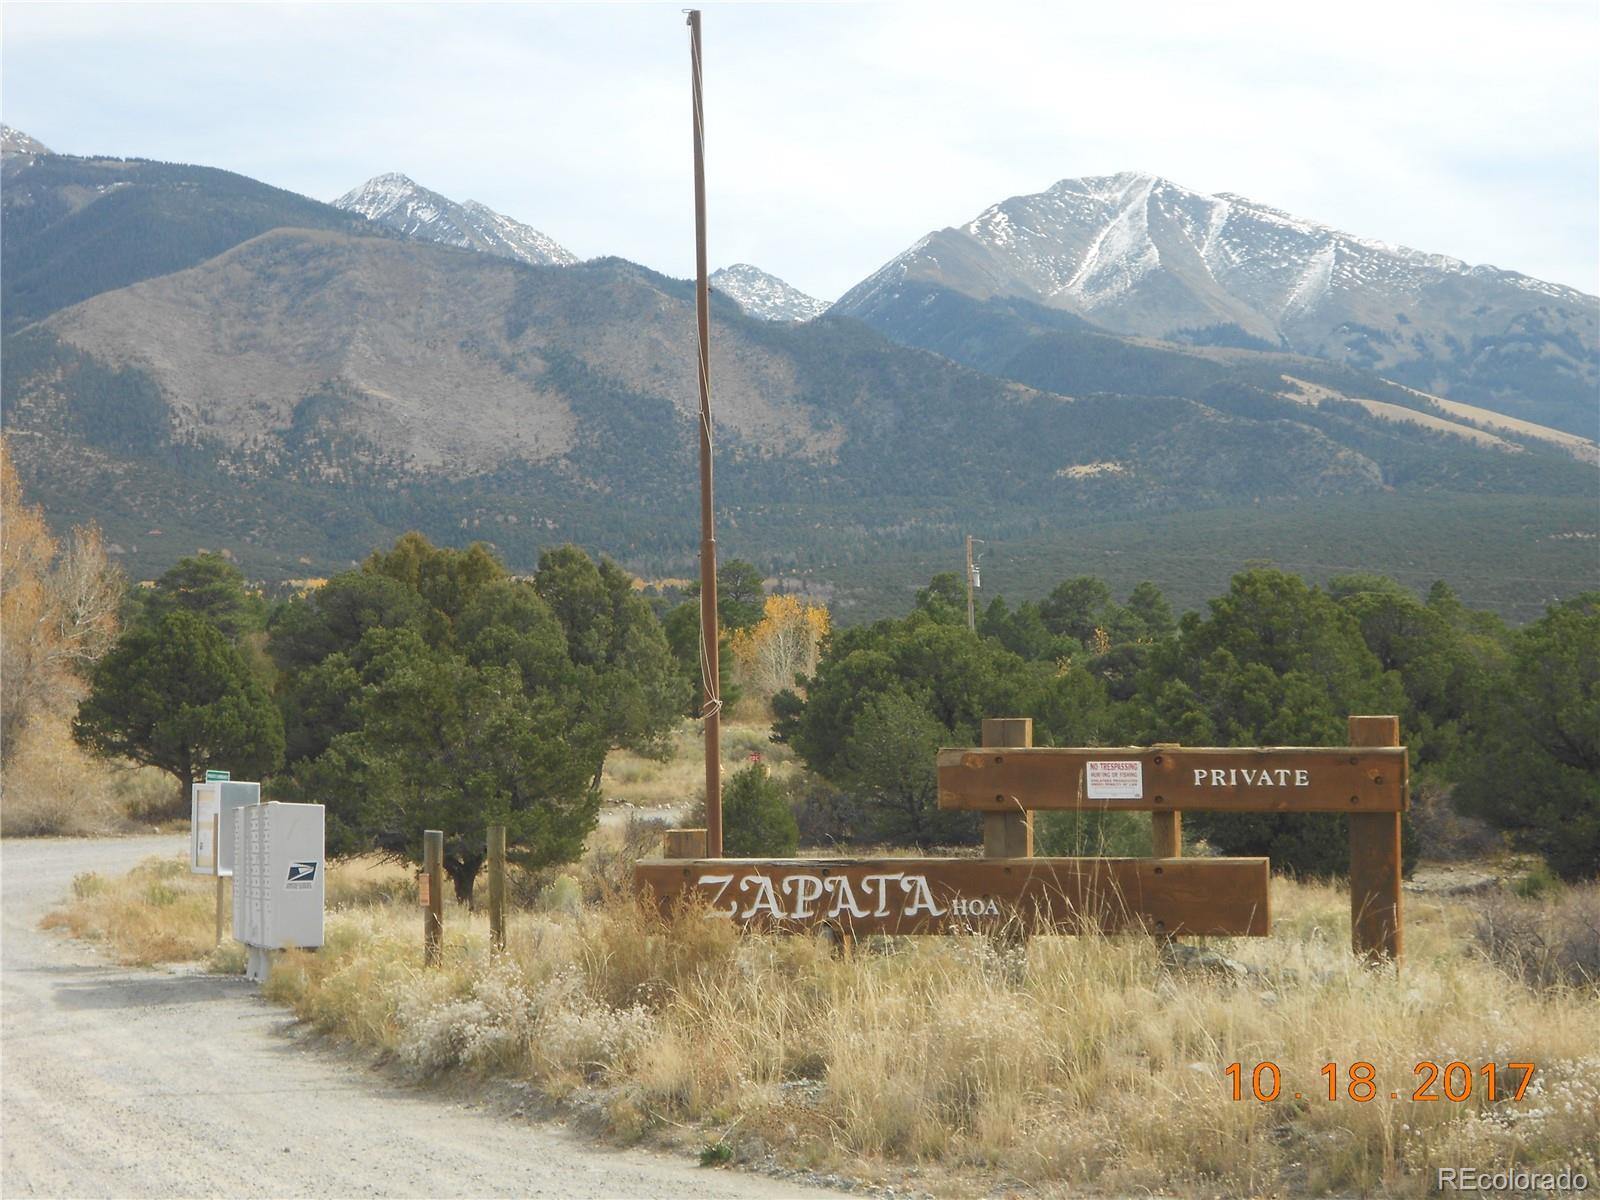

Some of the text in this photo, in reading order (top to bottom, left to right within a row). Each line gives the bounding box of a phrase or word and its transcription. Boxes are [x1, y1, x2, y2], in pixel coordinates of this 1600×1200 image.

[1090, 763, 1138, 771] NO TRESPASSING
[1193, 769, 1310, 786] PRIVATE
[698, 872, 1000, 918] ZAPATA HOA
